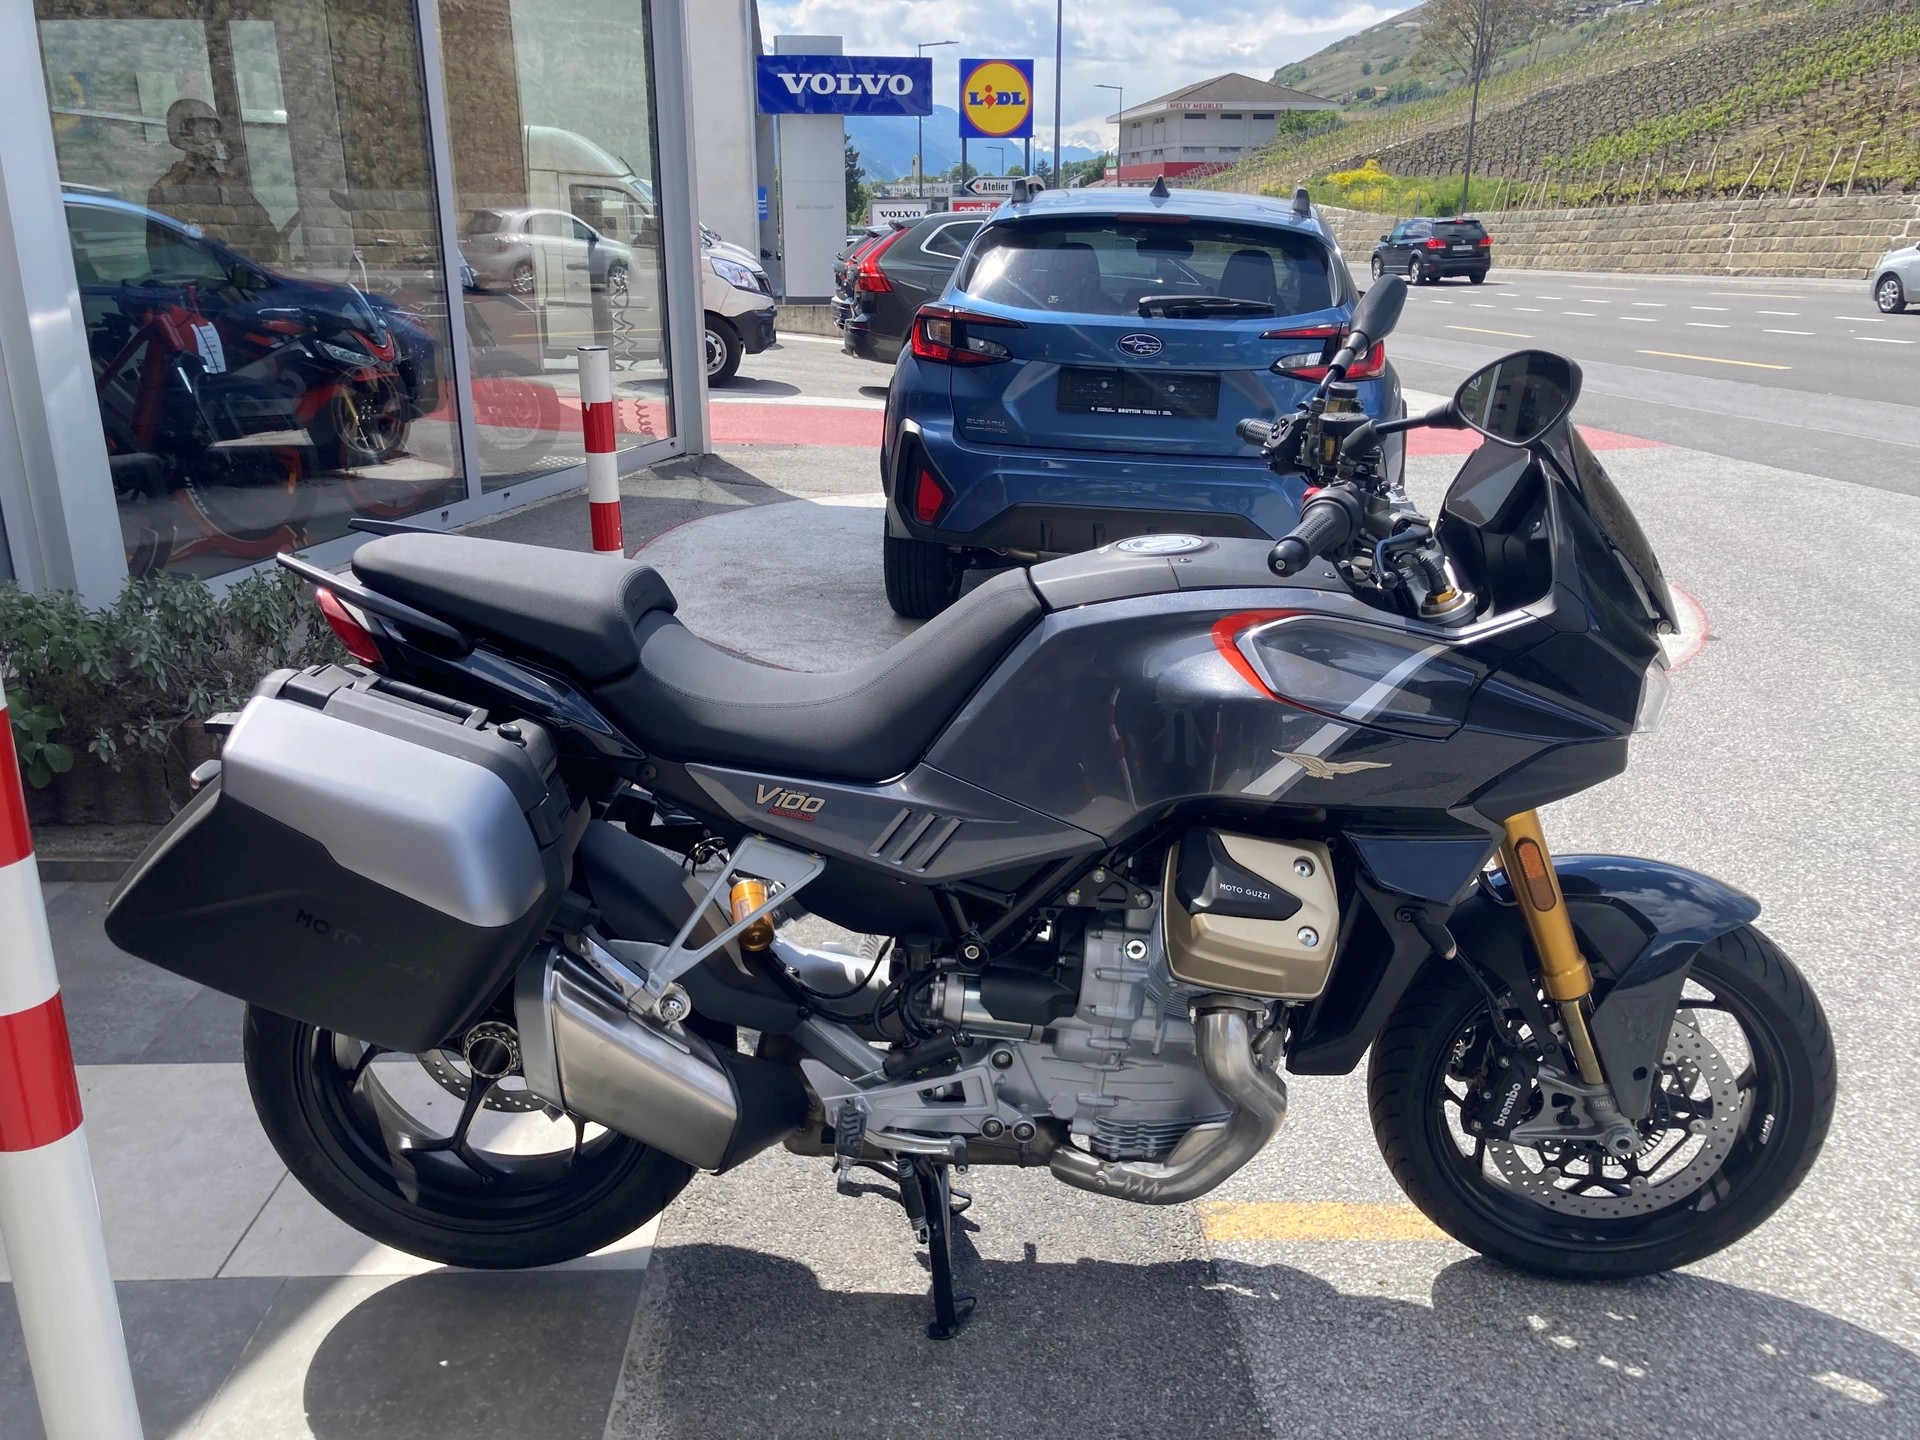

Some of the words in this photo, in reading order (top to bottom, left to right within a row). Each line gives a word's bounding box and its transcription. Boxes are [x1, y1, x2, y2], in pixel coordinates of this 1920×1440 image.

[777, 73, 914, 95] VOLVO
[1169, 102, 1191, 110] MELLY
[1192, 102, 1224, 110] MEUBLES
[982, 182, 1009, 191] Atelier
[878, 210, 921, 218] VOLVO
[756, 784, 826, 813] V100
[1219, 883, 1243, 893] MOTO
[1245, 889, 1270, 900] GUZZI
[1493, 1082, 1521, 1127] brembo
